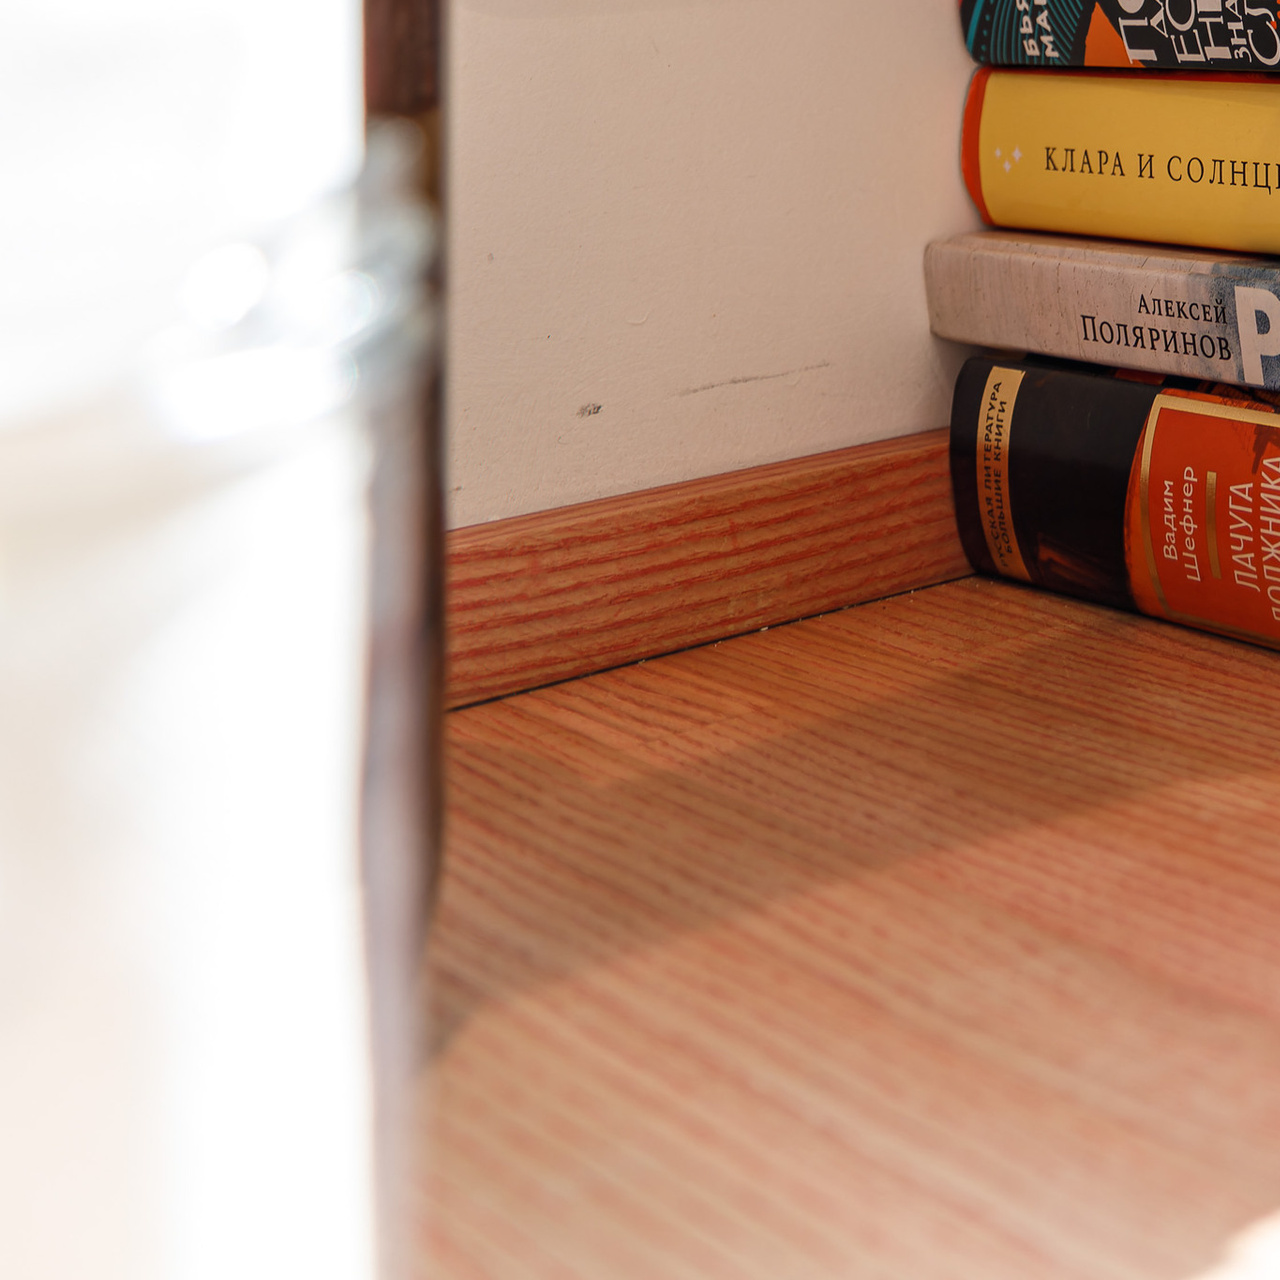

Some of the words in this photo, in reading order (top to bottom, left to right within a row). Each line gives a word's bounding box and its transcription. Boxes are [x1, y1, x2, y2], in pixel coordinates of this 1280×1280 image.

[1044, 146, 1127, 178] КЛАРА
[1136, 152, 1156, 180] И
[983, 381, 1002, 489] ЛИТЕРАТУРА
[994, 401, 1007, 460] КНИГИ
[994, 468, 1012, 552] БОЛЬШИЕ
[1163, 479, 1177, 559] Вадим
[1184, 466, 1200, 580] Шефнер
[1229, 482, 1259, 592] ЛАЧУГА
